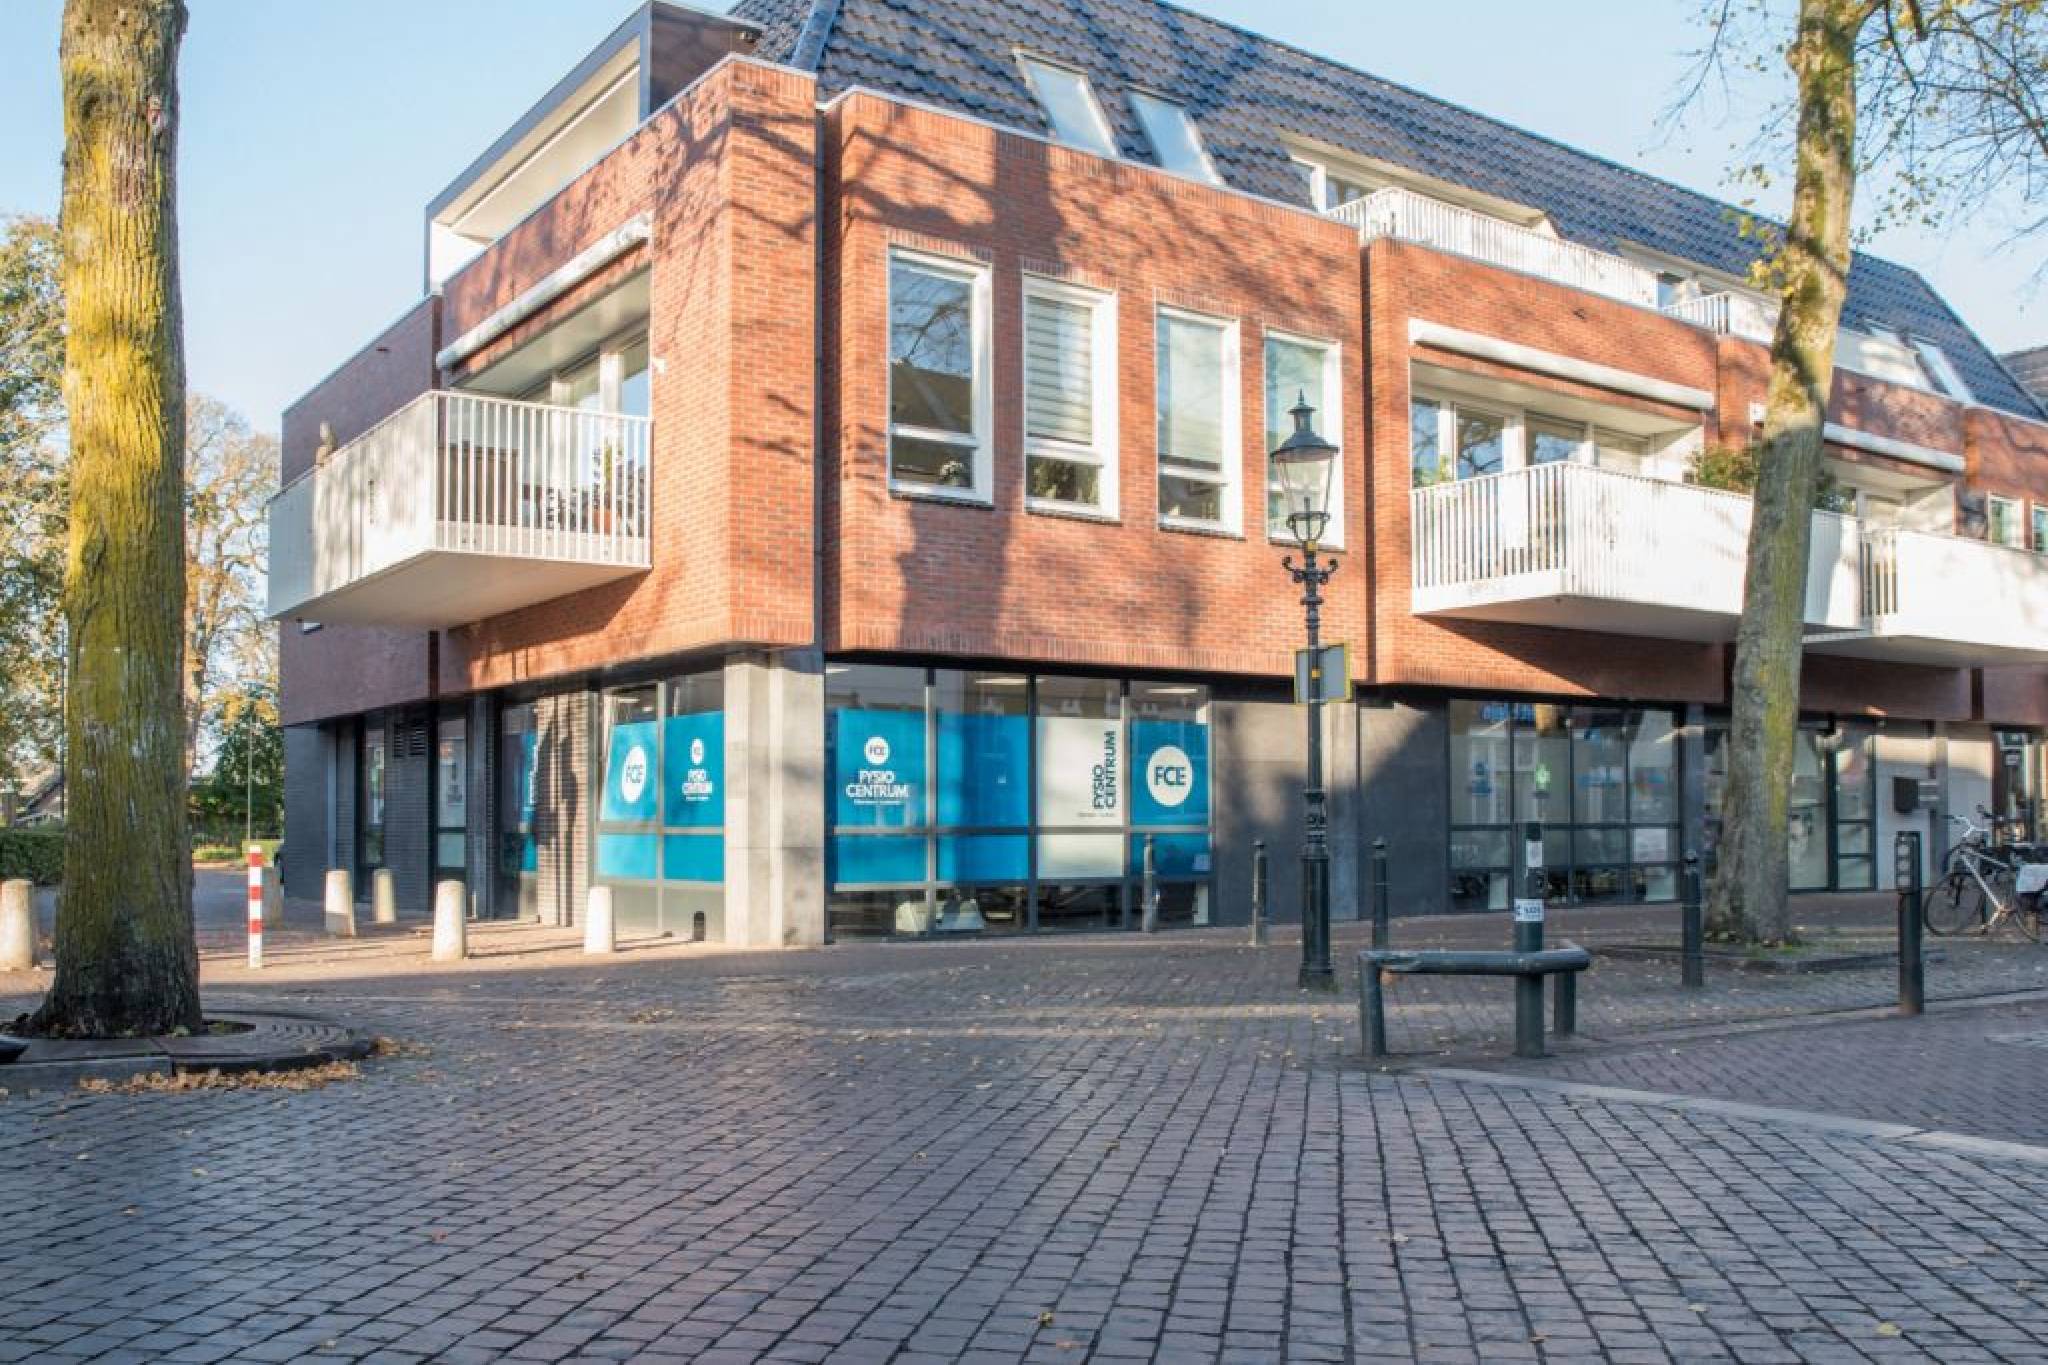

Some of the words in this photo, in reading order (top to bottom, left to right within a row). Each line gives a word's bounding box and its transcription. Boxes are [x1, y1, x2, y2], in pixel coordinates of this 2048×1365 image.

[859, 770, 895, 784] FYSIO
[1105, 731, 1116, 808] CENTRUM
[1154, 766, 1186, 785] FCE
[846, 784, 909, 798] CENTRUM
[1093, 765, 1104, 809] FYSIO
